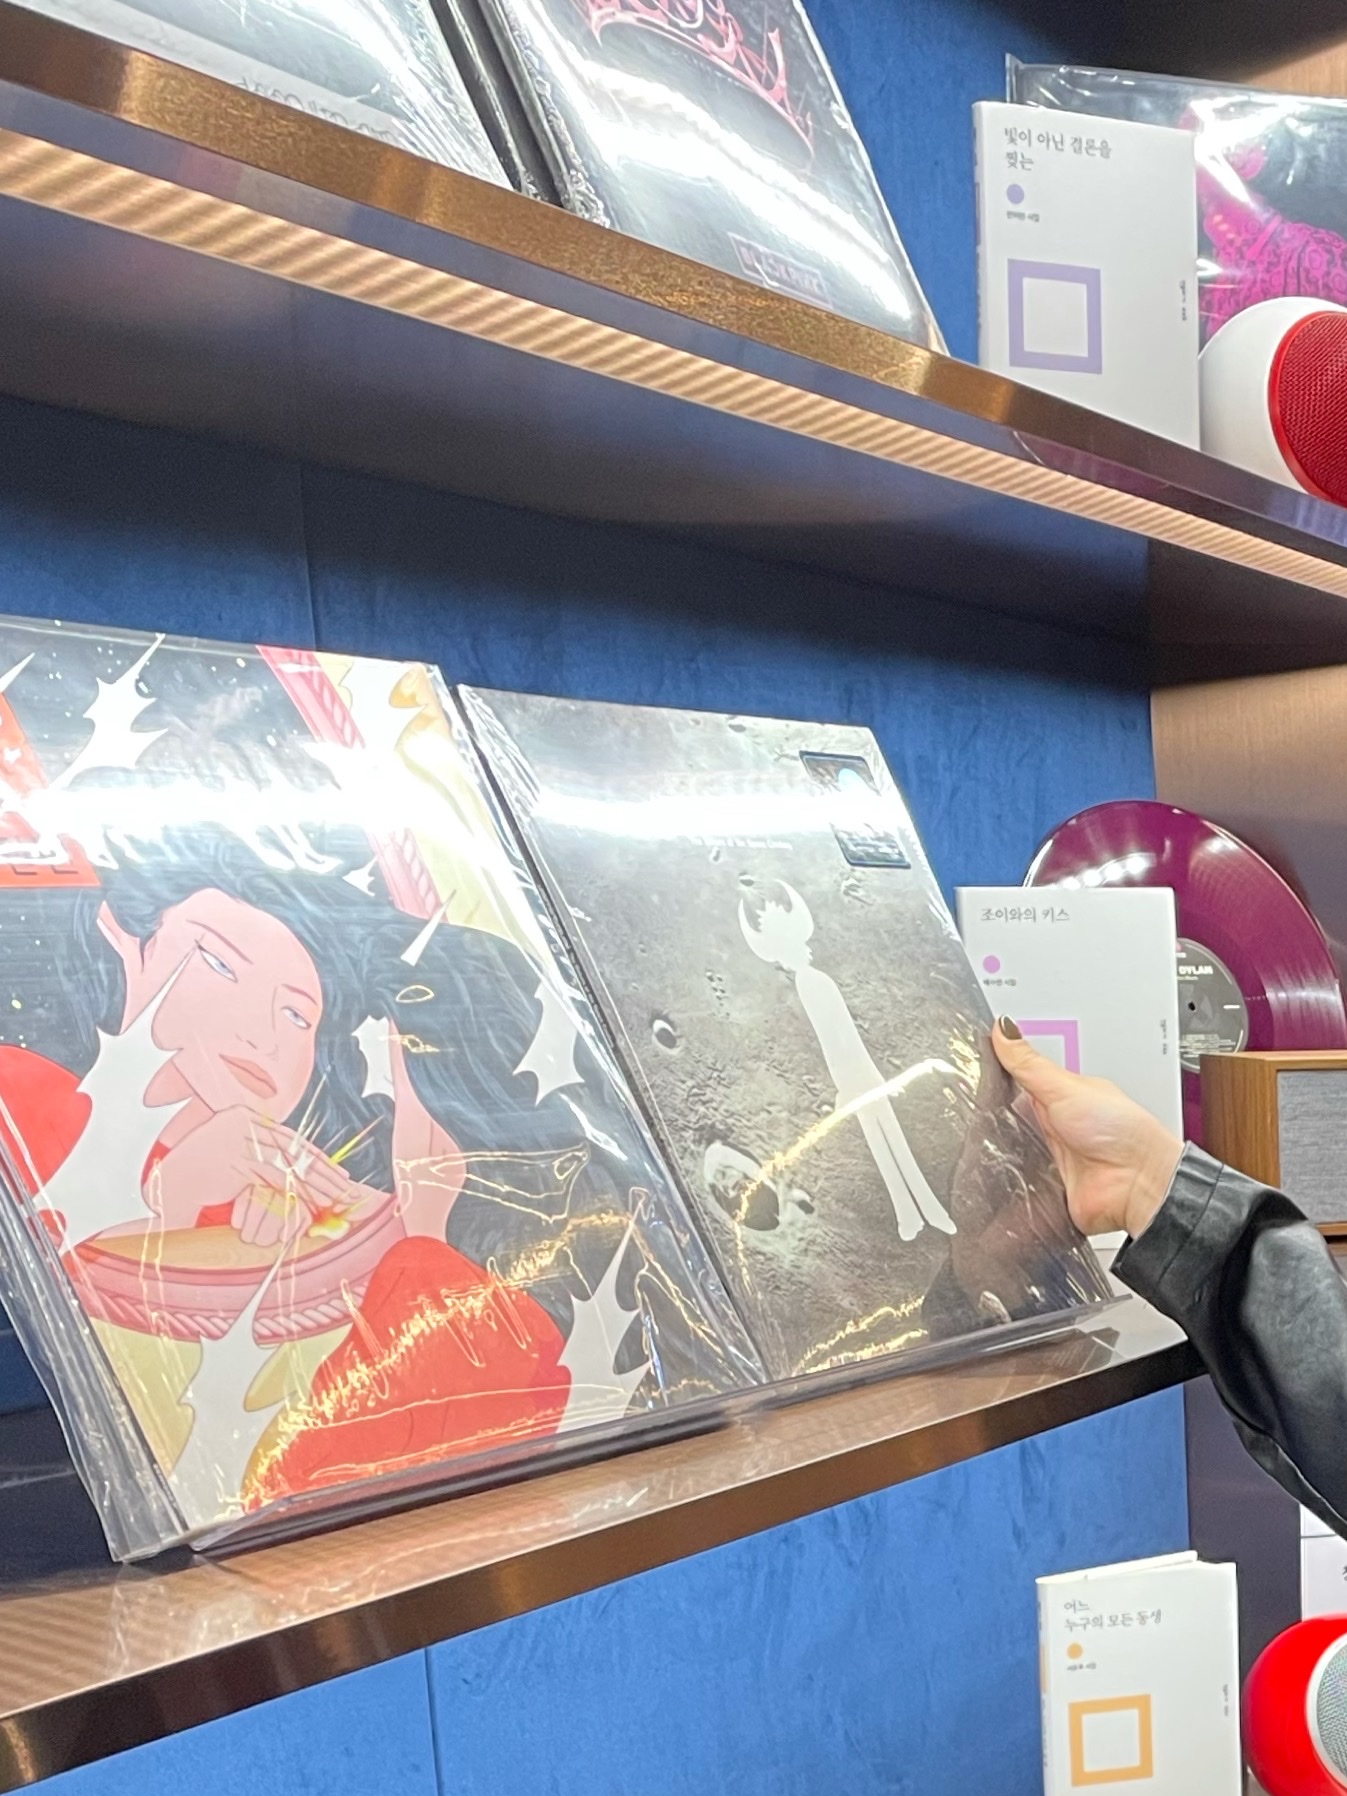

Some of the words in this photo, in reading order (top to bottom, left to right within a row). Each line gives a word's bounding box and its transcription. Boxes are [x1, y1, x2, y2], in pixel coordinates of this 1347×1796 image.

[1005, 127, 1032, 147] 빛이
[1037, 131, 1064, 152] 아닌
[1070, 136, 1112, 159] 결론을
[1006, 151, 1034, 171] 찢는
[981, 907, 1036, 923] 조이와의
[1042, 907, 1071, 923] 키스
[1179, 965, 1213, 975] DYLAN
[1064, 1599, 1090, 1613] 어느
[1064, 1614, 1103, 1632] 누구의
[1107, 1613, 1134, 1627] 모든
[1136, 1609, 1161, 1625] 동생
